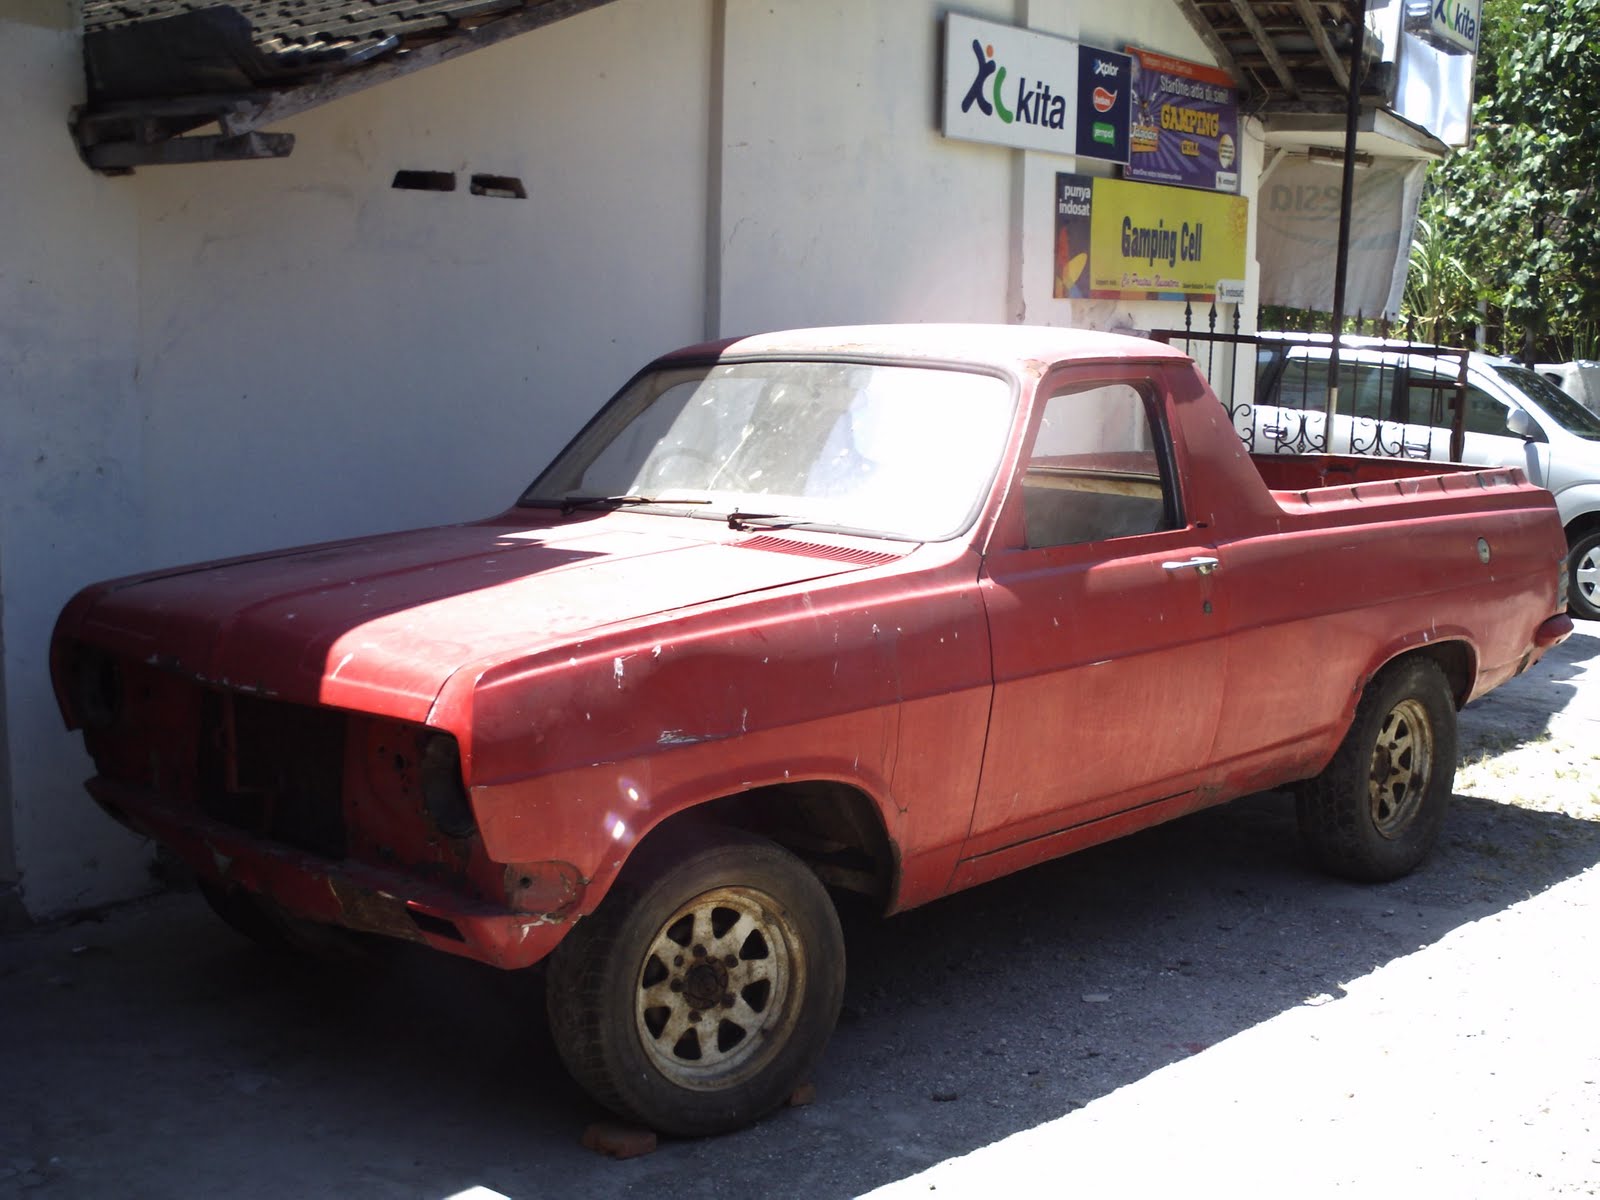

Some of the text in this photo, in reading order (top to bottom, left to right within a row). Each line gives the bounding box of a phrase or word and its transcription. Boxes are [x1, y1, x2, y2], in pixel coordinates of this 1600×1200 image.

[1455, 3, 1475, 41] kita
[1016, 77, 1066, 130] kita
[1191, 83, 1204, 99] ada
[1205, 86, 1212, 101] di
[1161, 103, 1219, 138] GAMPING
[1059, 200, 1090, 217] indosat
[1064, 185, 1091, 200] punya
[1122, 216, 1203, 268] Gamping Cell
